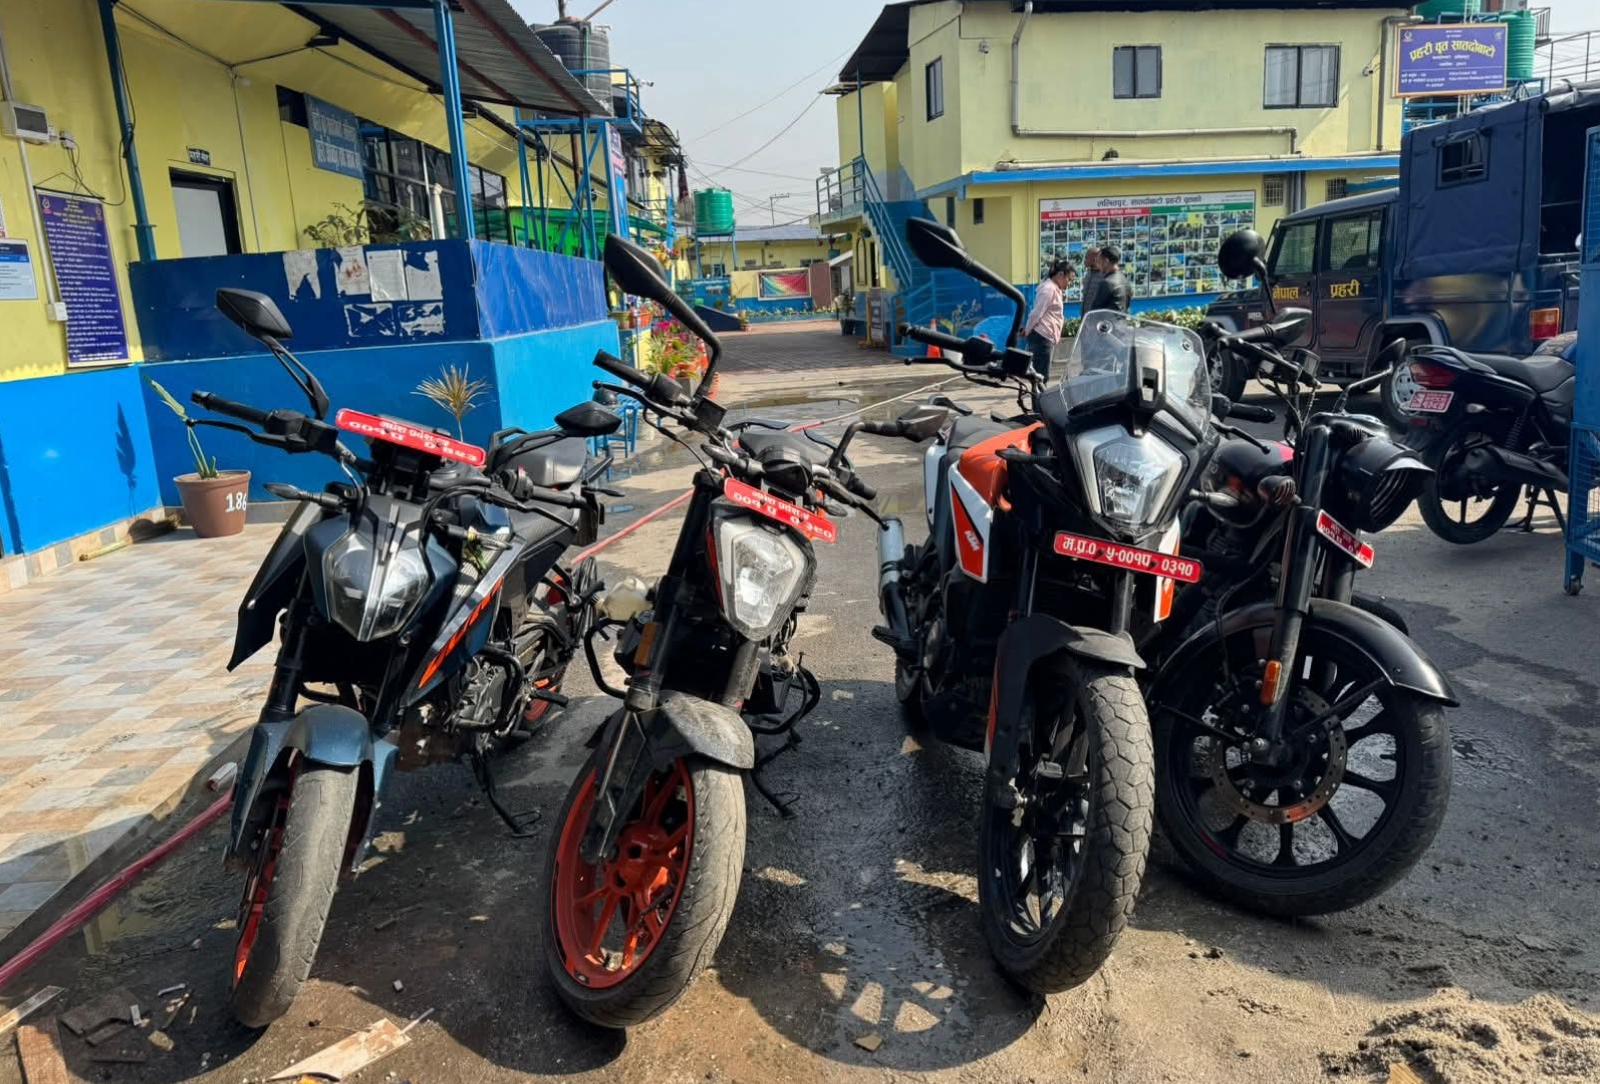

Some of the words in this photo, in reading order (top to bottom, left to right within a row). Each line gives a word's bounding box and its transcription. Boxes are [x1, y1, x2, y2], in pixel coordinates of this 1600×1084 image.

[1409, 43, 1433, 62] प्रहरी
[1272, 285, 1299, 300] नेपाल
[1330, 279, 1361, 298] प्रहरी
[225, 491, 247, 513] 186
[964, 530, 980, 551] KTM
[1161, 559, 1194, 577] ०३१०
